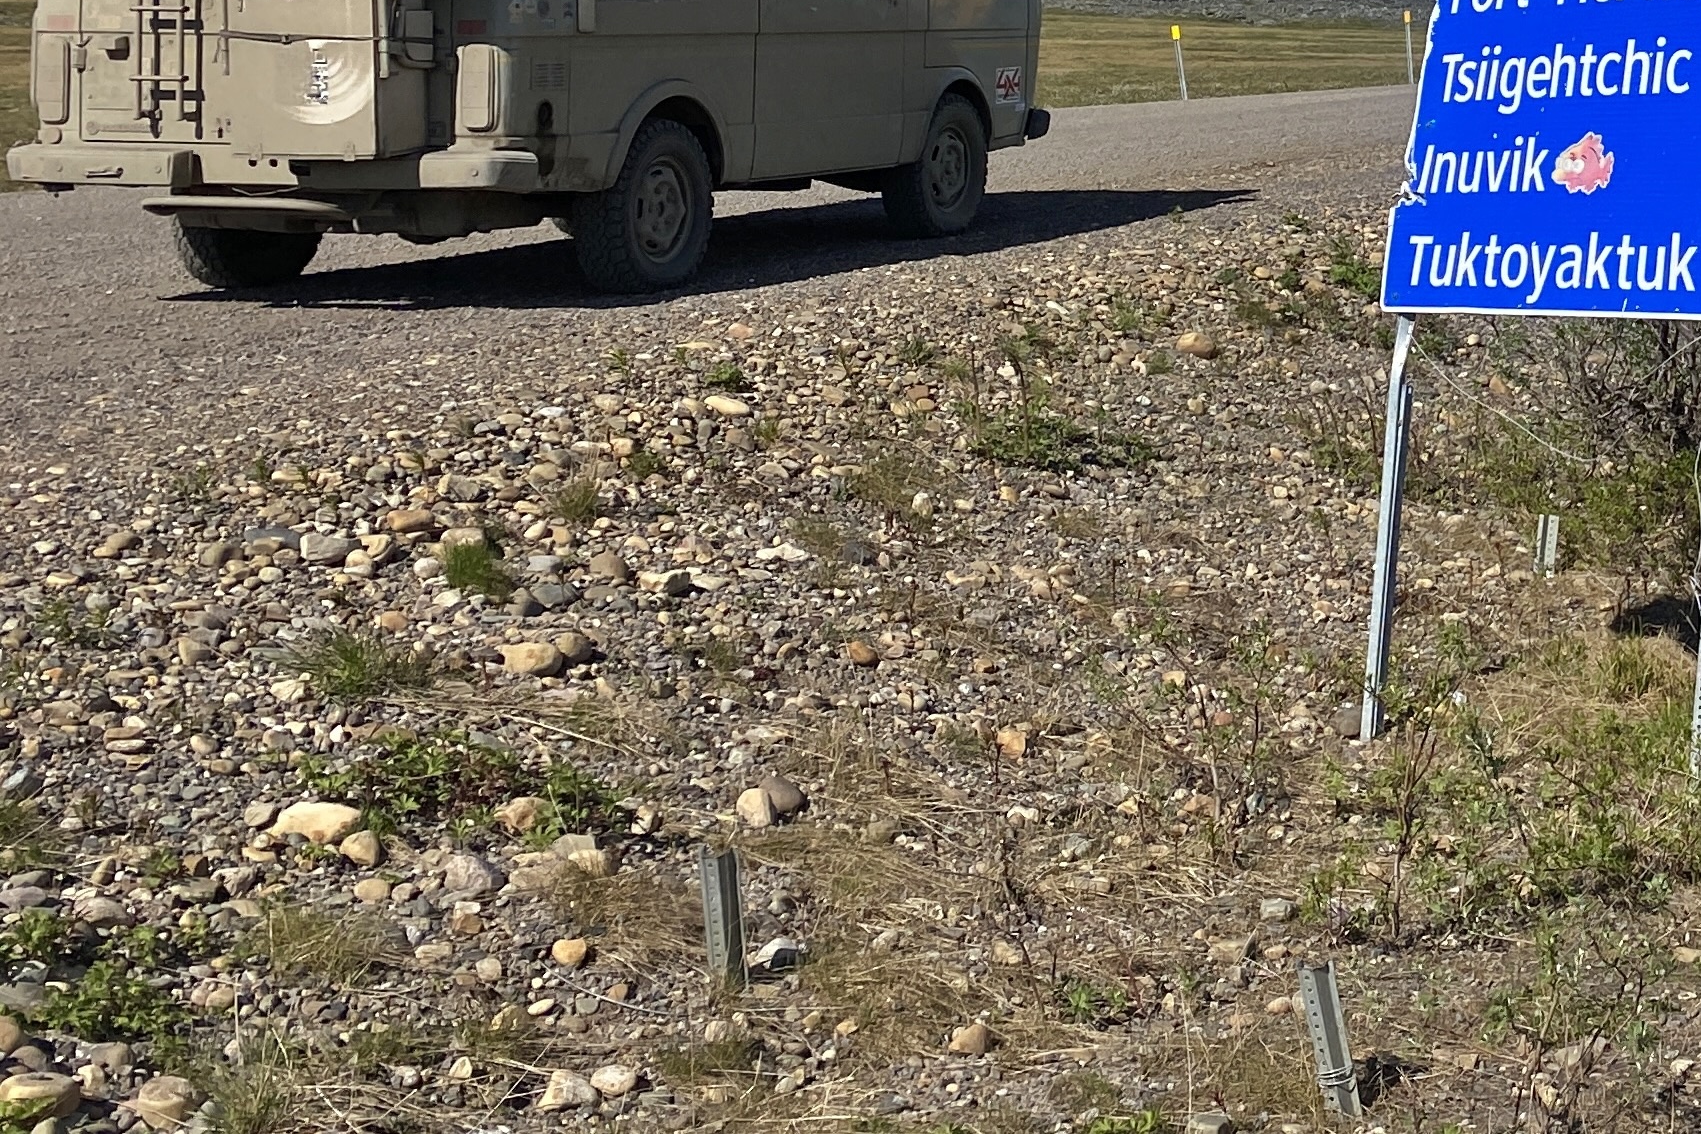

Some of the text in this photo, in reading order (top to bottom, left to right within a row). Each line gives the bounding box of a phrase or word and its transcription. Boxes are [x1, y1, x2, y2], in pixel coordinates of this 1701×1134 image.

[1443, 37, 1692, 114] Tsiigehtchic
[1417, 136, 1548, 194] Inuvik
[1410, 232, 1697, 304] Tuktoyaktuk
